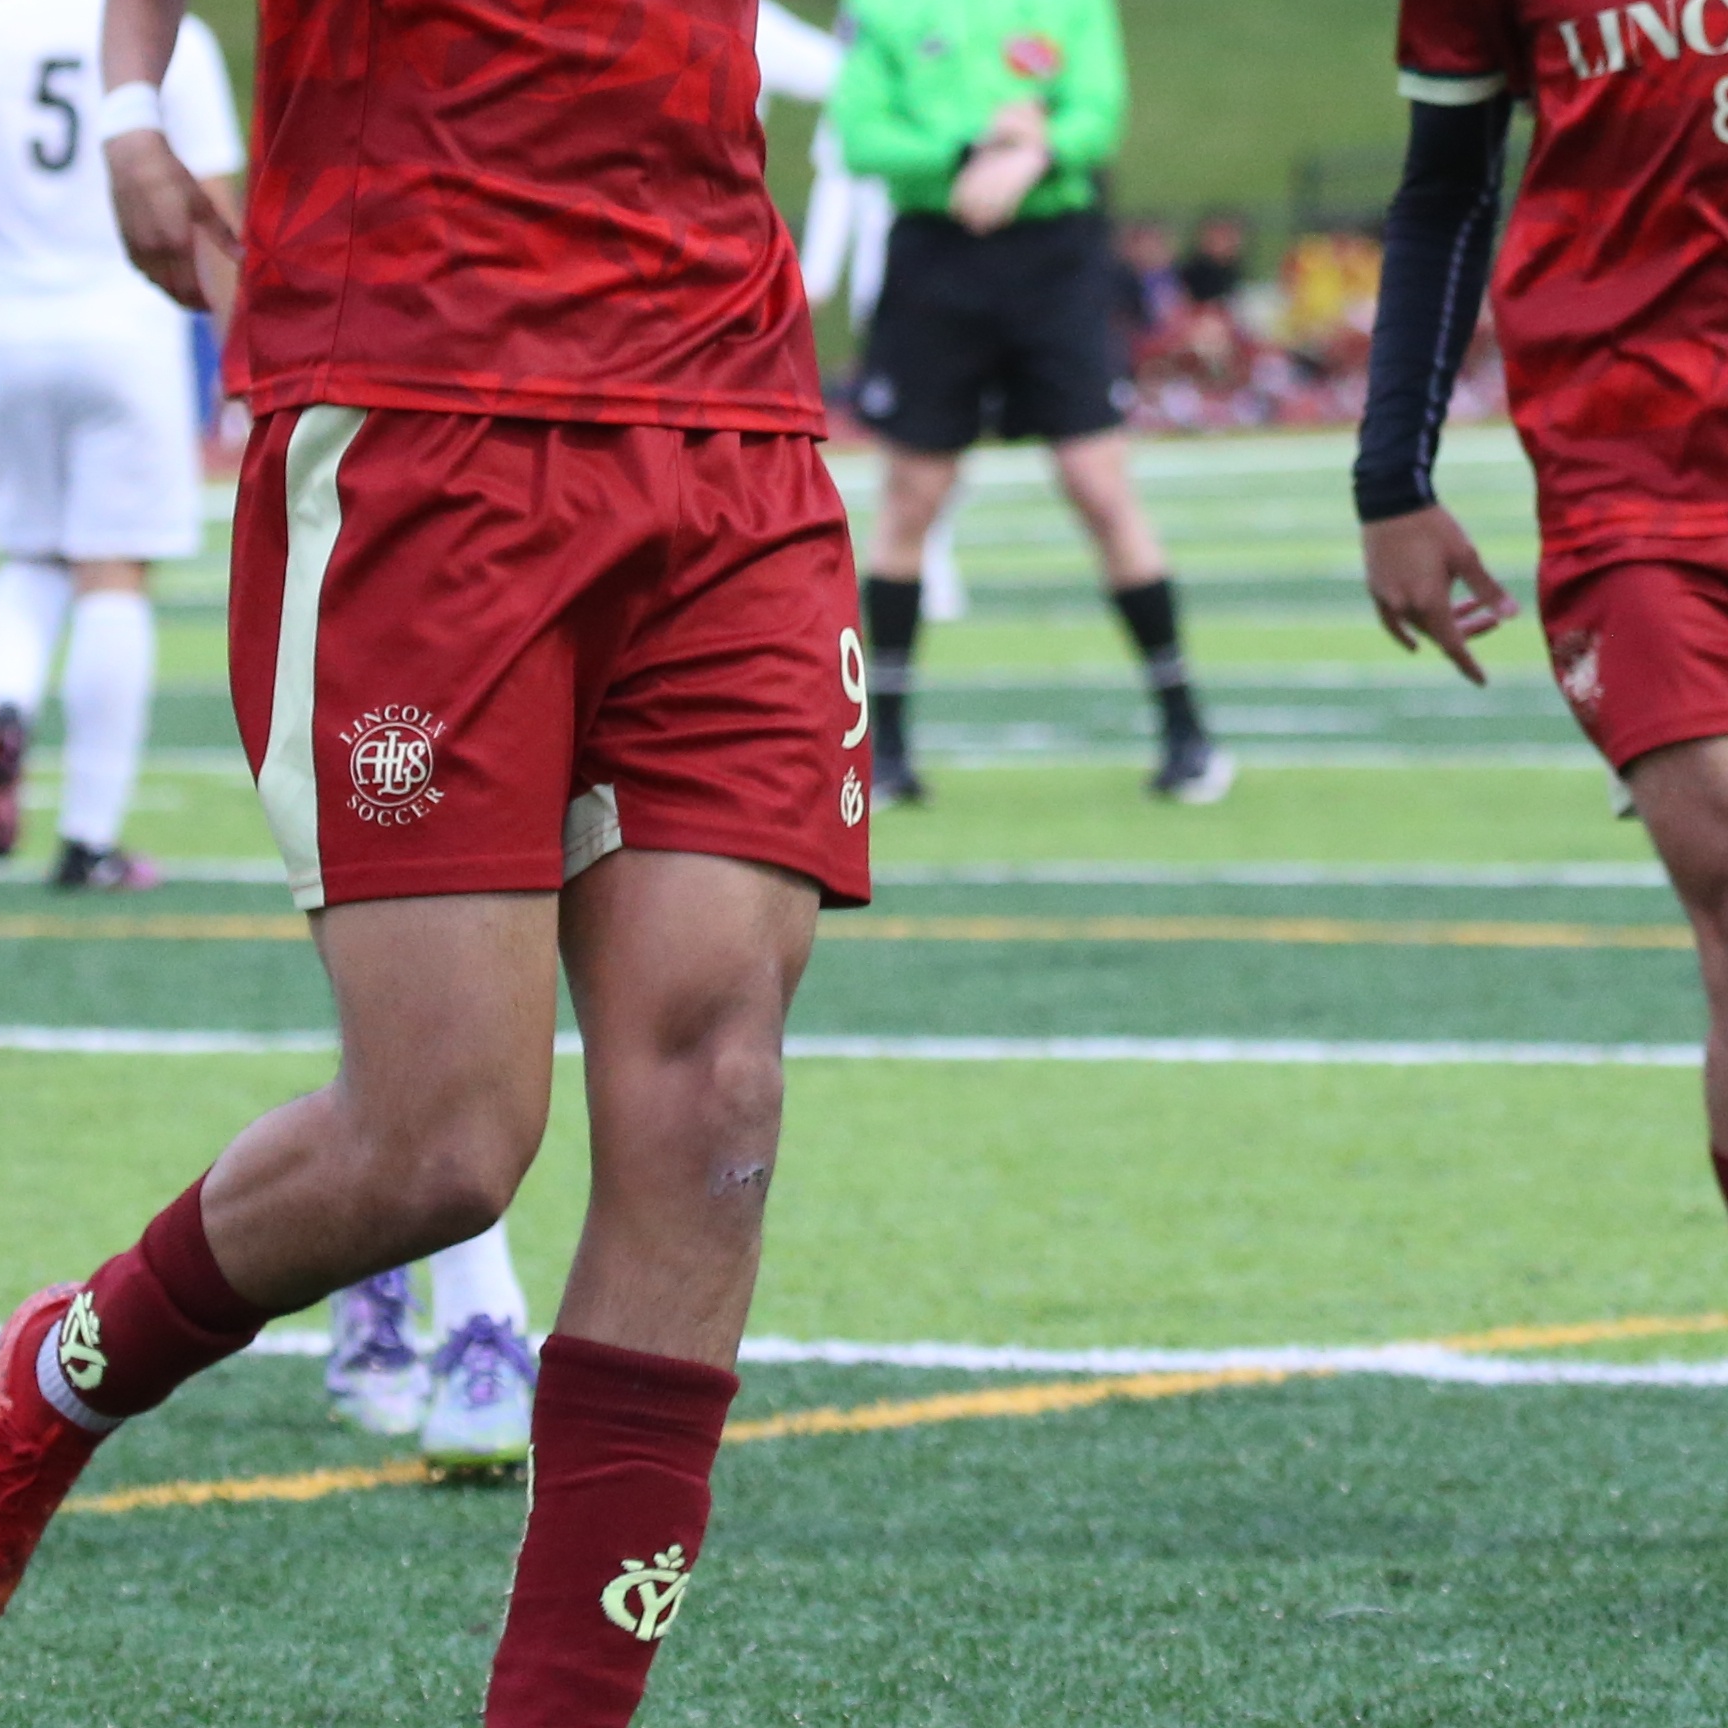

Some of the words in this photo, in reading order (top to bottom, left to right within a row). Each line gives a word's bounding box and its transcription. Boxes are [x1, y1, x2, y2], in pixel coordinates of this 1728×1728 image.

[31, 57, 81, 173] 5
[338, 704, 447, 746] LINCOLN
[839, 626, 869, 750] 9
[346, 786, 445, 827] SOCCER
